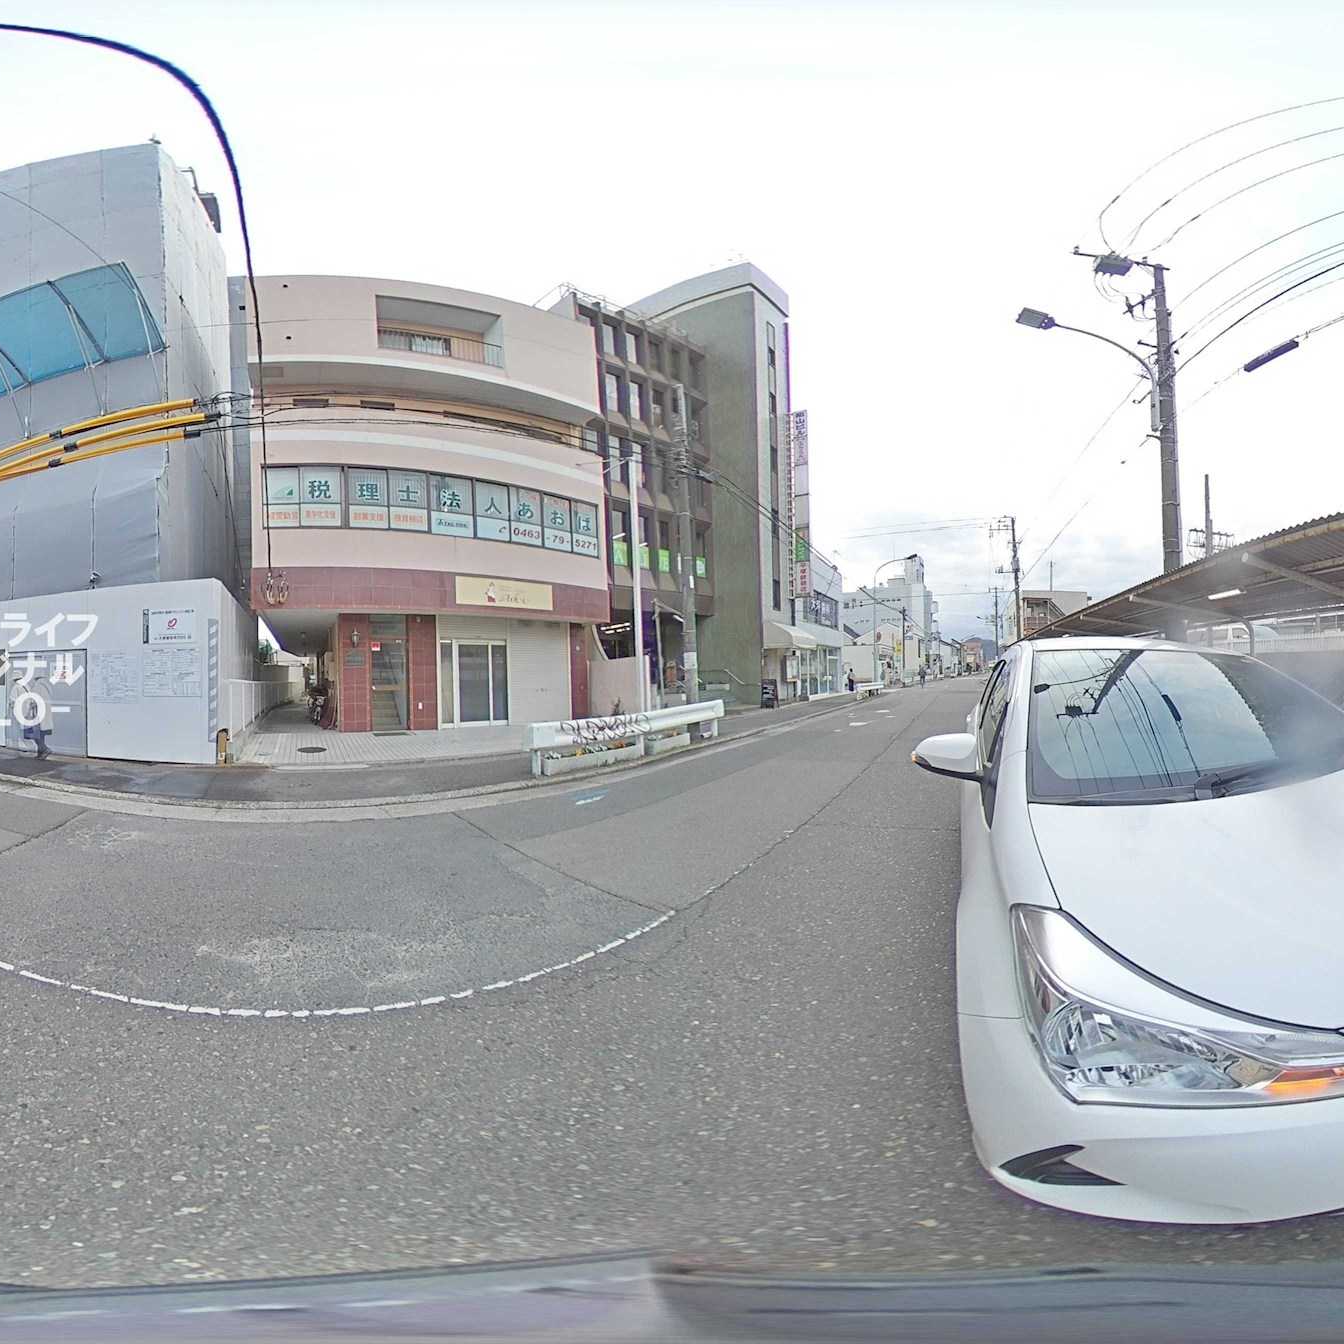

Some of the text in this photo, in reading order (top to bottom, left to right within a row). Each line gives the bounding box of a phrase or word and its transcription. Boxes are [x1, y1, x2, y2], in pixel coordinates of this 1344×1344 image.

[307, 479, 592, 532] 税理士法人あおば
